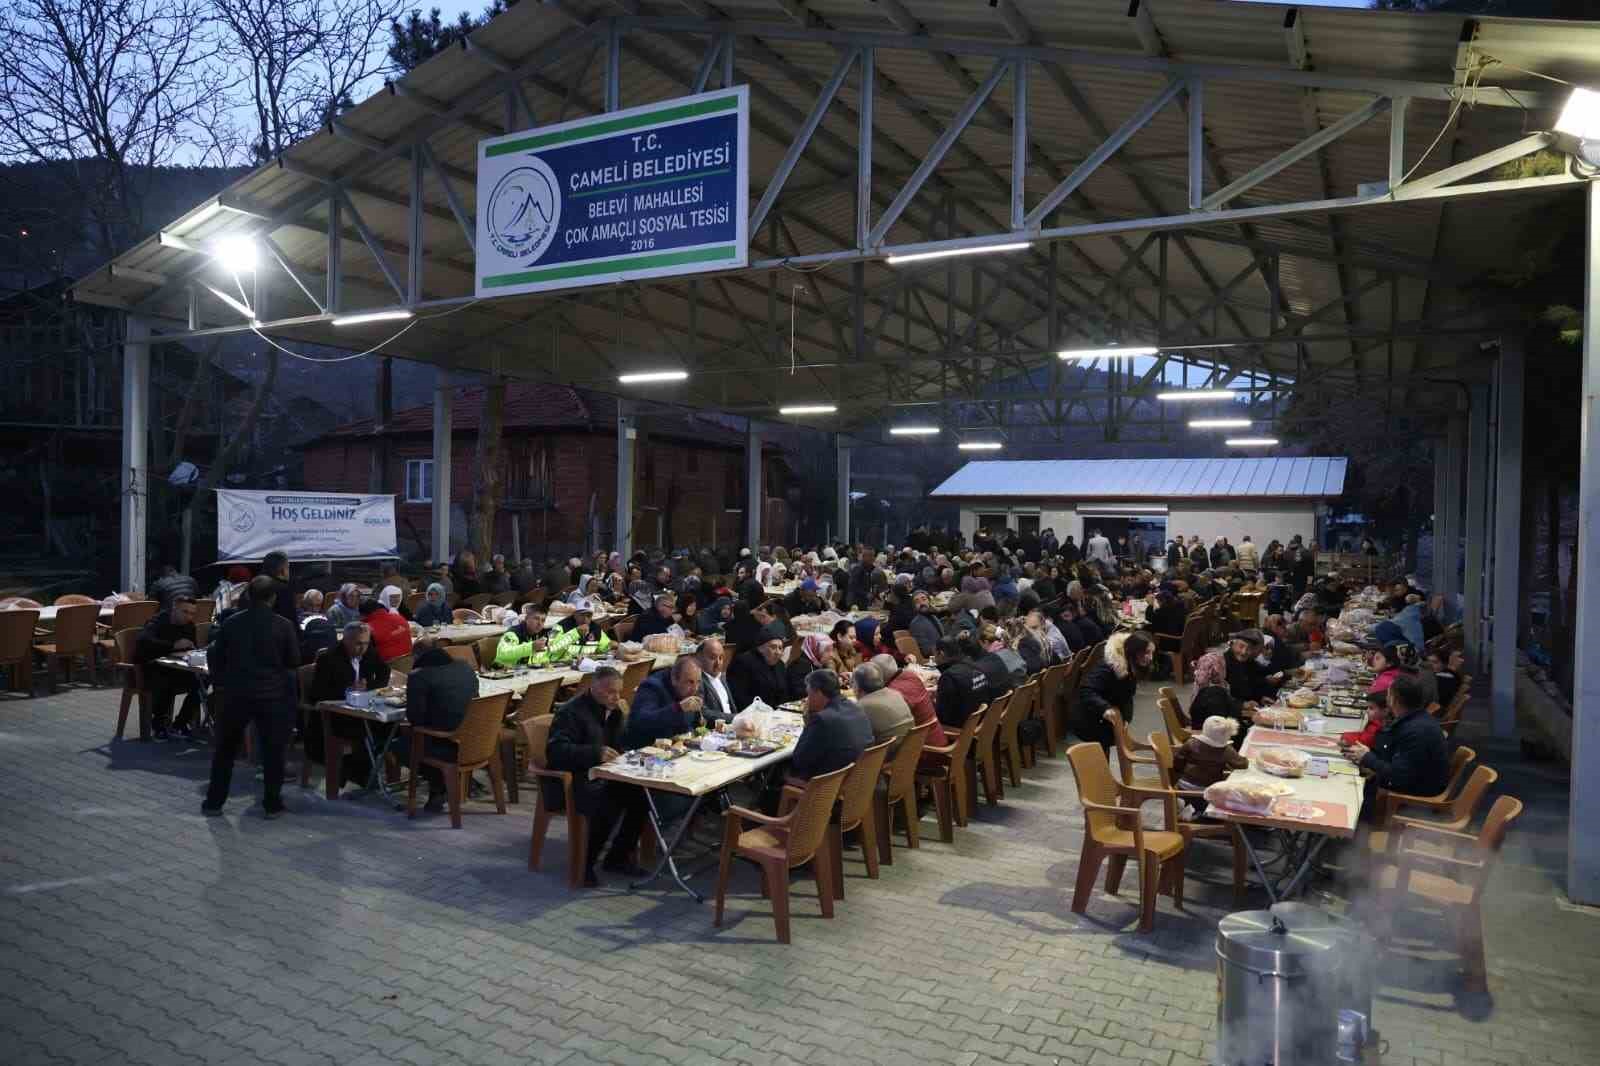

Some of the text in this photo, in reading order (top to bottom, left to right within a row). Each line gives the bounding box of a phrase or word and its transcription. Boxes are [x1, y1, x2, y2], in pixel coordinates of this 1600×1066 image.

[632, 134, 662, 153] T.C.
[570, 142, 730, 190] ÇAMELİ BELEDİYESİ
[588, 181, 704, 218] BELEVİ MAHALLESİ
[565, 202, 729, 249] ÇOK AMAÇLI SOSYAL TESİSİ
[631, 238, 655, 251] 2016
[271, 506, 357, 522] HOŞ GELDİNİZ
